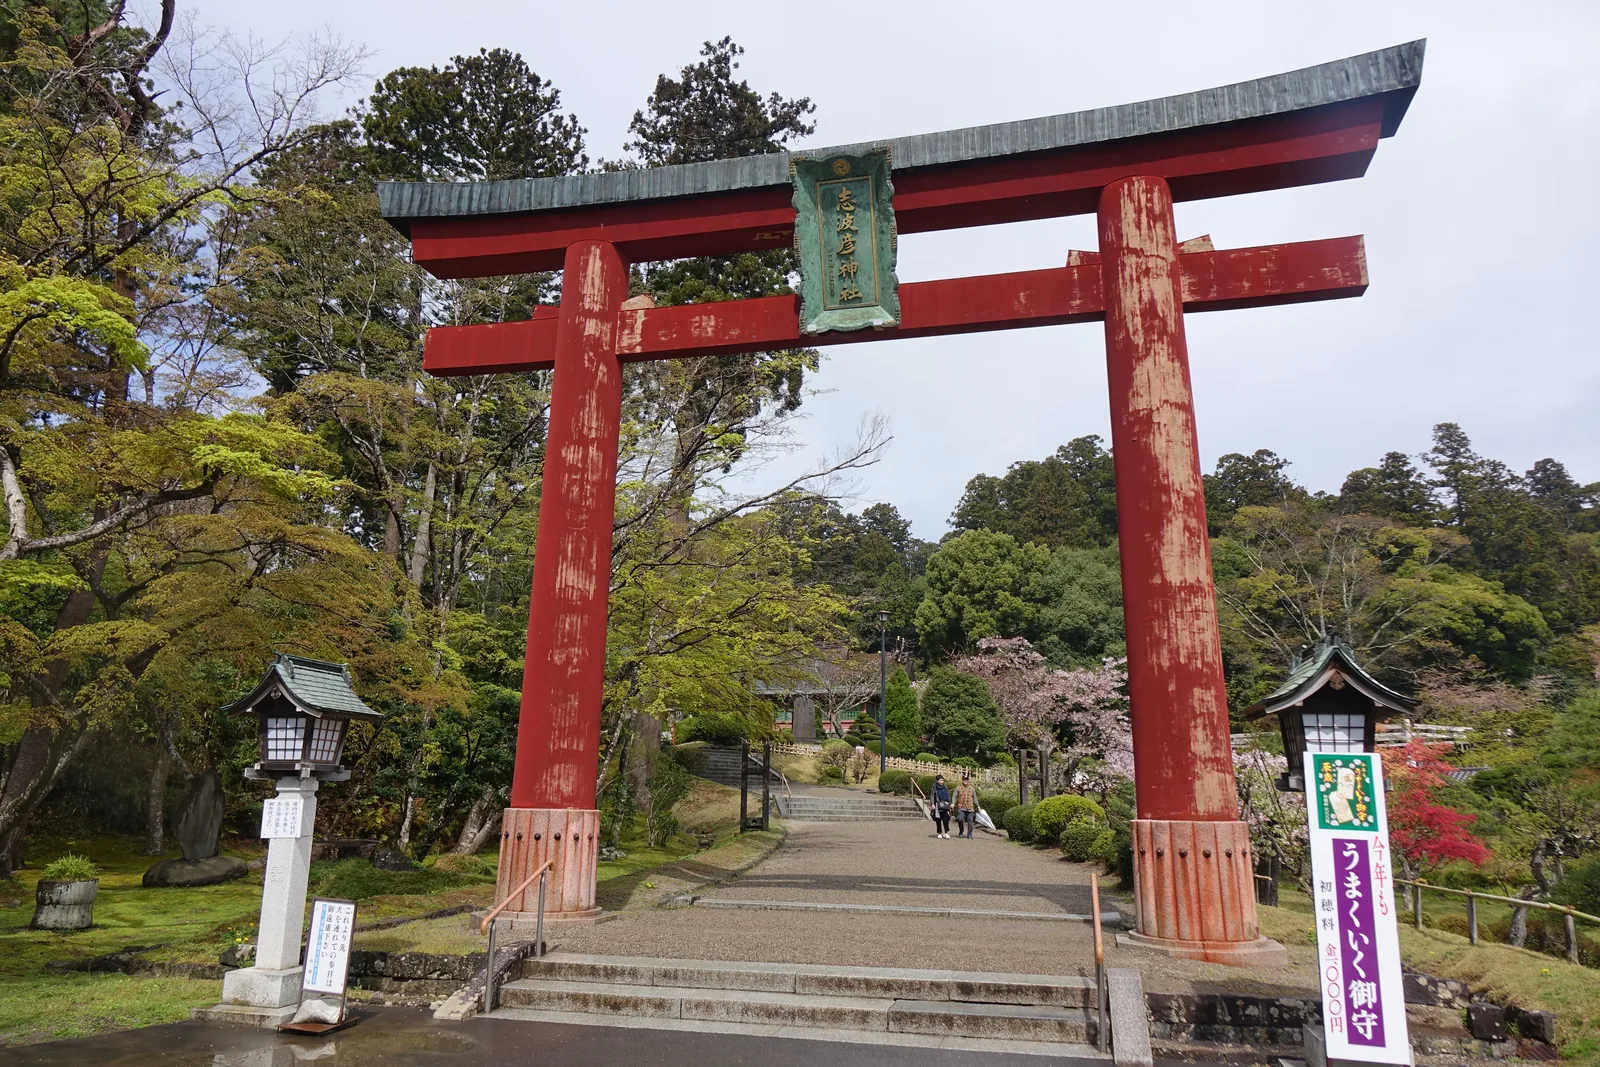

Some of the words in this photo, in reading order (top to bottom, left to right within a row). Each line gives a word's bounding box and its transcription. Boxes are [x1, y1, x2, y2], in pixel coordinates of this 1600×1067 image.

[836, 186, 863, 301] 志波彦神社
[1320, 880, 1334, 931] 初穂料
[1372, 835, 1389, 916] 今年も
[321, 905, 334, 958] 御遠慮下さい
[326, 906, 343, 987] 犬を連れての参拝は
[339, 907, 350, 952] これより先
[1342, 842, 1378, 1040] うまくいく御守
